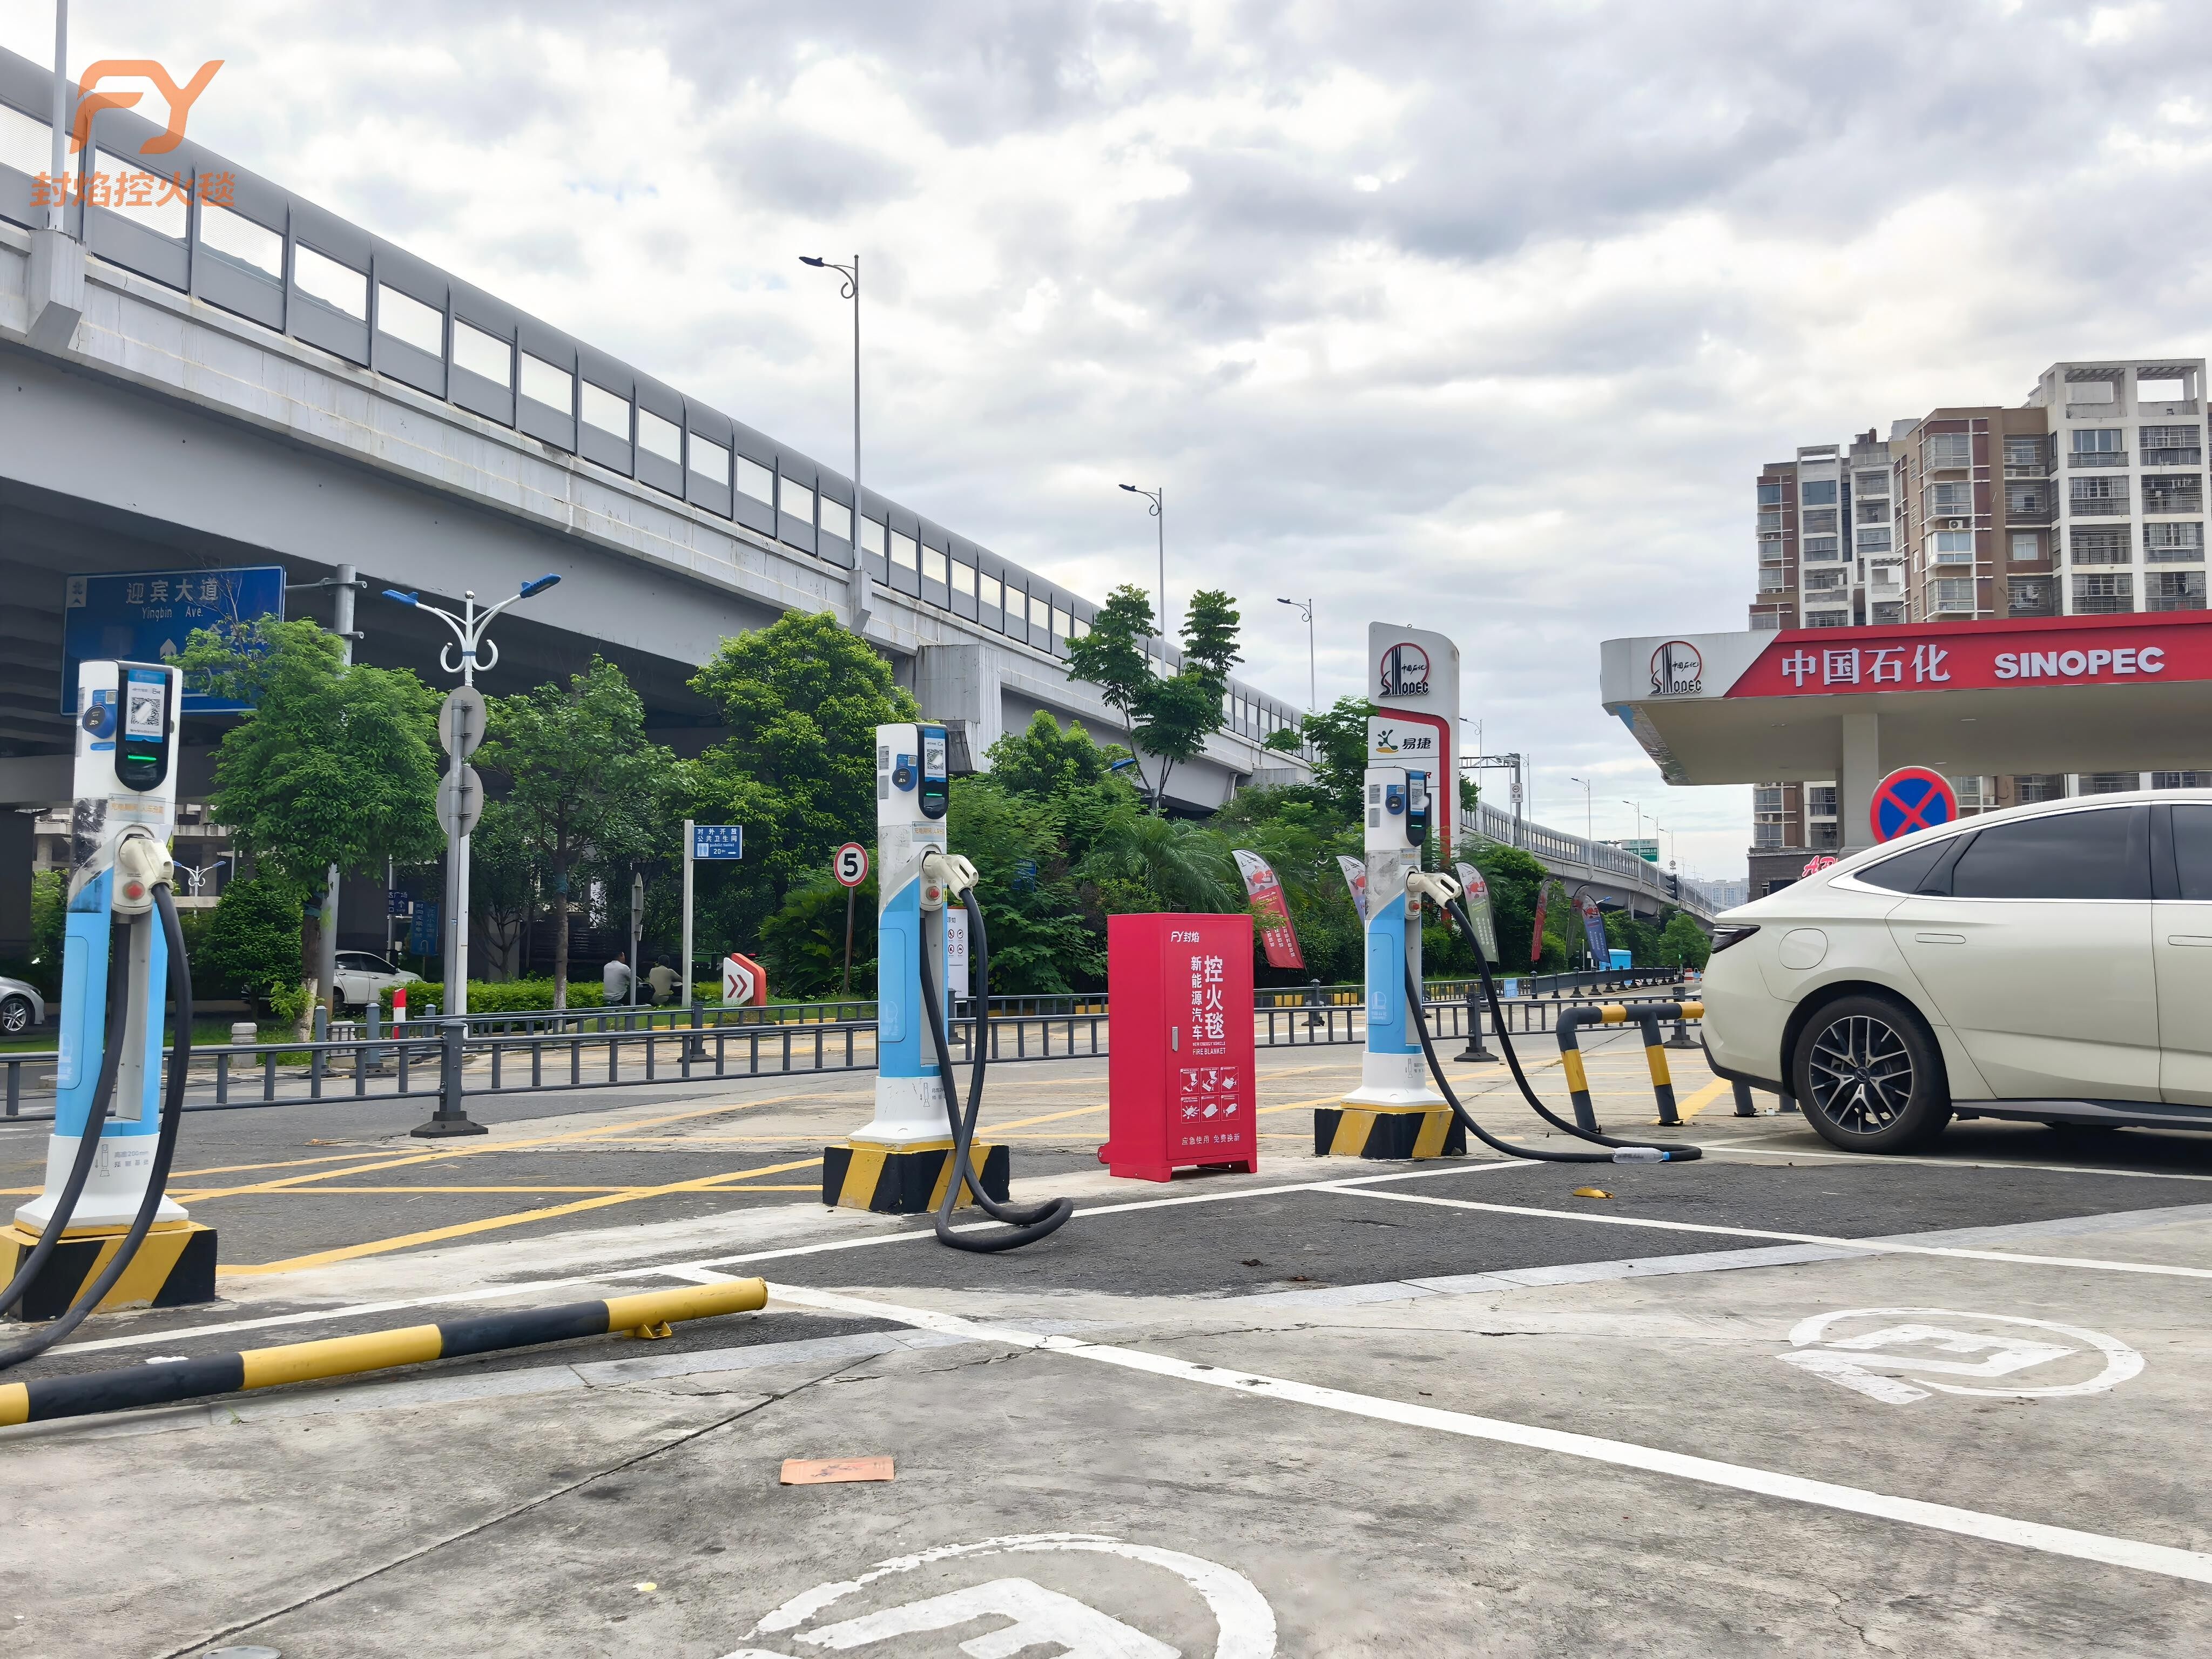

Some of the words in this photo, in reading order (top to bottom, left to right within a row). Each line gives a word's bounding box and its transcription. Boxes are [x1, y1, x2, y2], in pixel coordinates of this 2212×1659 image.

[125, 578, 219, 604] 迎宾大道
[141, 606, 173, 622] Yingbin
[185, 606, 203, 617] Ave.
[1782, 643, 1951, 687] 中国石化
[1994, 647, 2165, 679] SINOPEC
[1401, 737, 1432, 750] 易捷
[843, 853, 858, 877] 5
[1191, 956, 1203, 1040] 新能源汽车
[1204, 955, 1225, 1039] 控火毯
